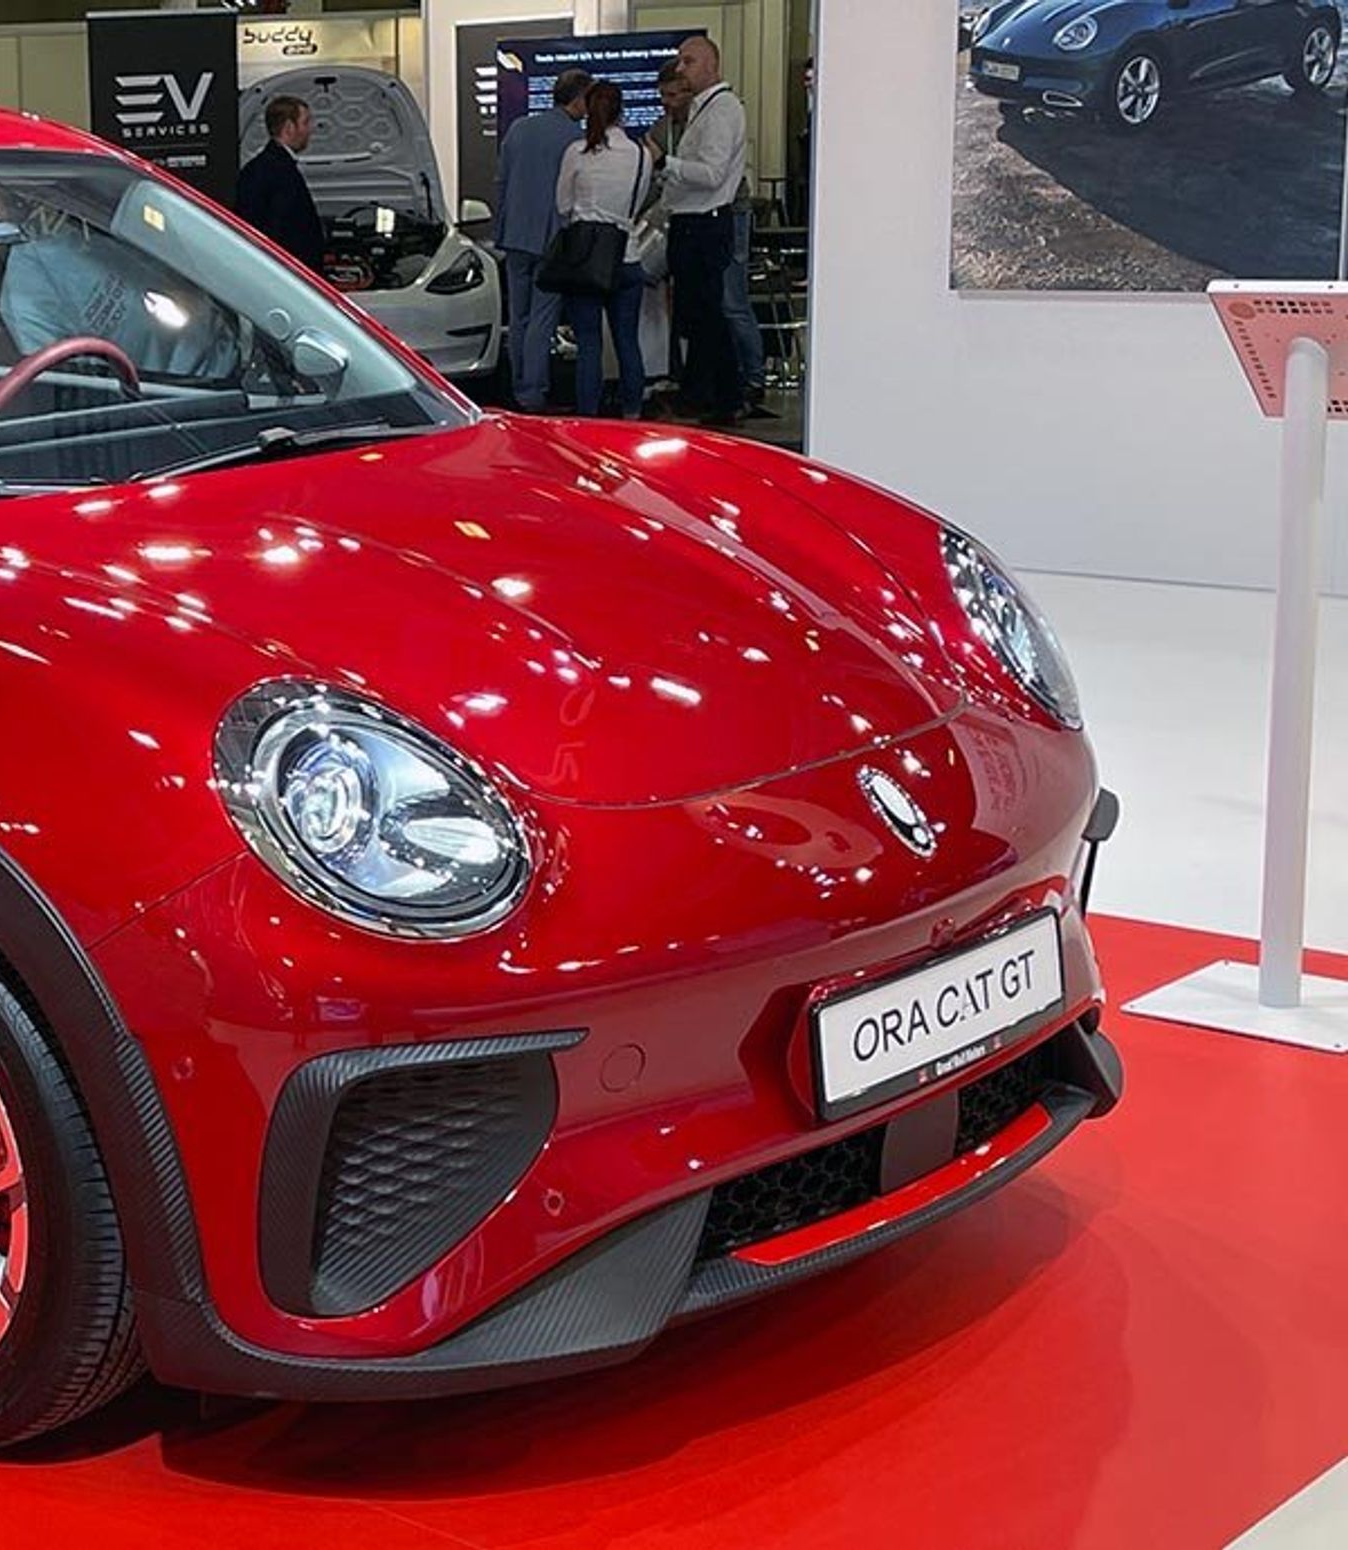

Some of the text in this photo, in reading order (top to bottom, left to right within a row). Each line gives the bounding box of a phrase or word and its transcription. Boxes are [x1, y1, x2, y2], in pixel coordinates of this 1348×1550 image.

[114, 72, 214, 124] EV
[121, 123, 211, 138] SERVICES
[852, 950, 1035, 1062] ORA CAT GT
